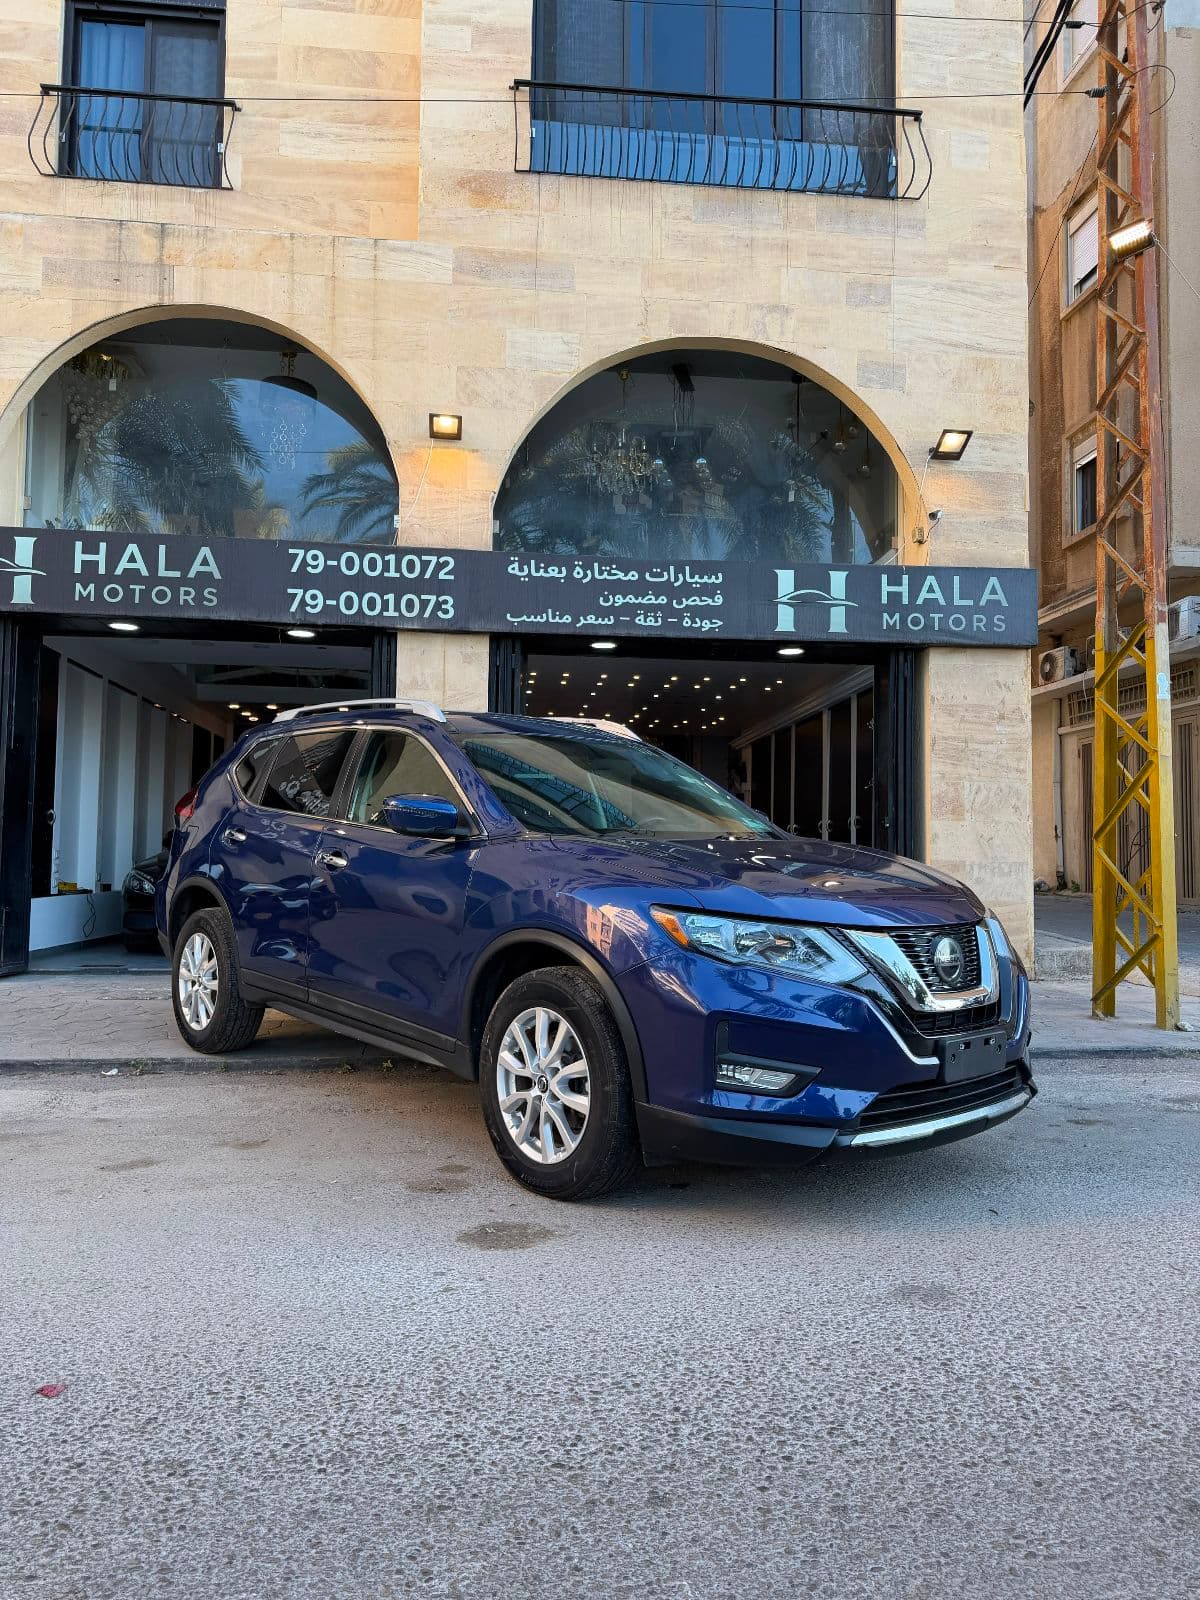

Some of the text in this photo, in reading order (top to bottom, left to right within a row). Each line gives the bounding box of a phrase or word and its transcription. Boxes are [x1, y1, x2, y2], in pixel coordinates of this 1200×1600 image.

[74, 541, 222, 580] HALA
[288, 548, 455, 580] 79-001072
[508, 557, 723, 588] سيارات مختارة بعناية
[74, 582, 219, 607] MOTORS
[599, 590, 723, 609] فحص مضمون
[881, 574, 1009, 607] HALA
[286, 588, 455, 619] 79-001073
[506, 609, 572, 628] مناسب
[576, 613, 615, 628] سعر
[635, 609, 663, 627] ثقة
[683, 613, 724, 632] جودة
[882, 612, 1007, 632] MOTORS
